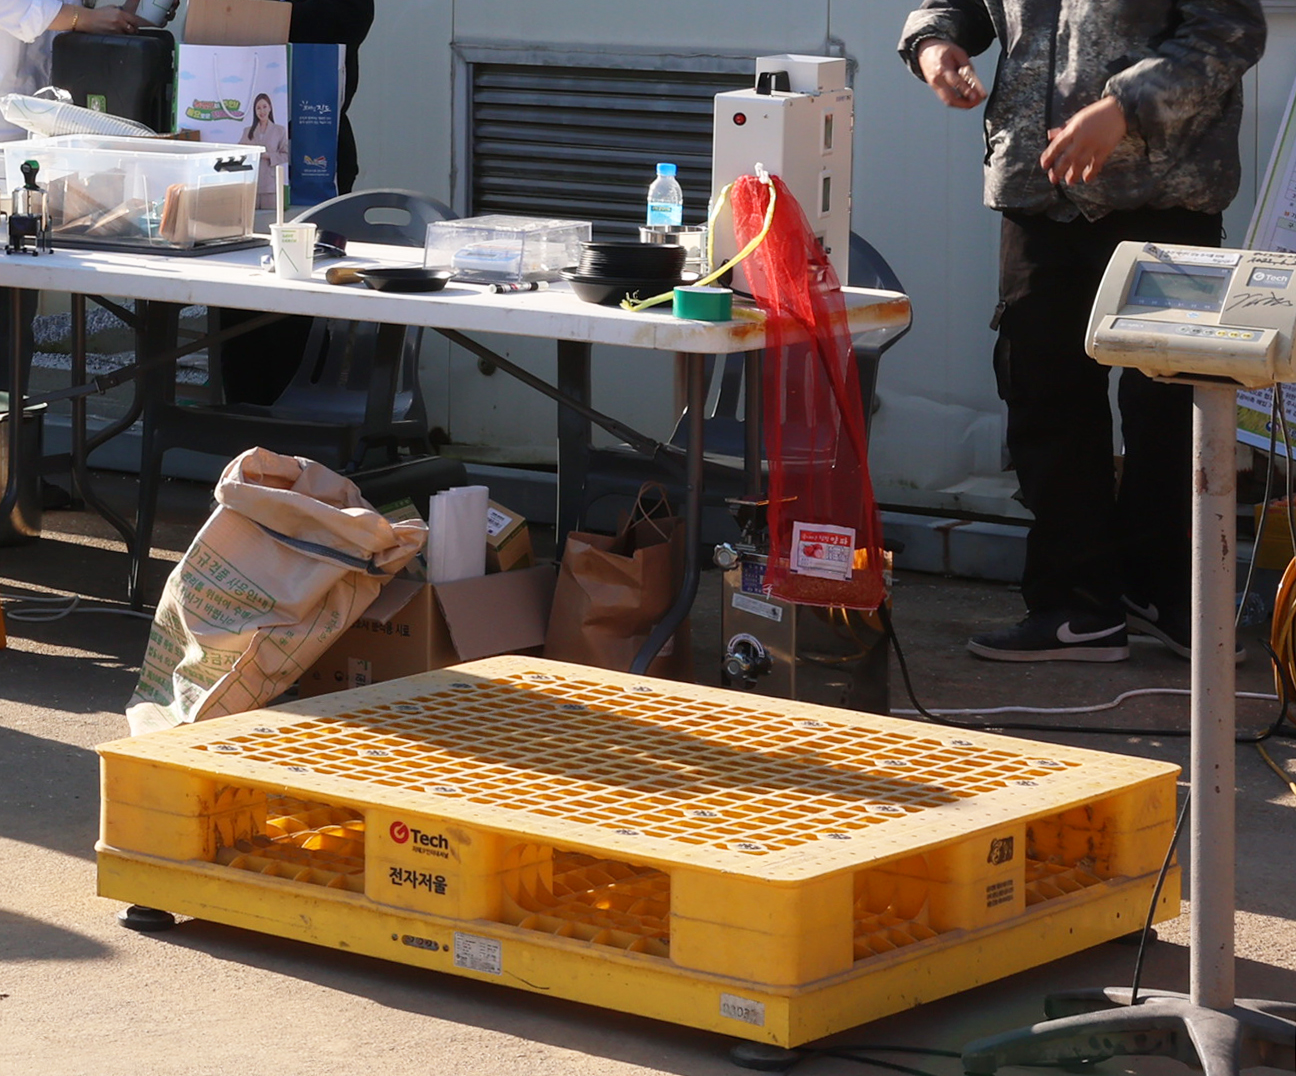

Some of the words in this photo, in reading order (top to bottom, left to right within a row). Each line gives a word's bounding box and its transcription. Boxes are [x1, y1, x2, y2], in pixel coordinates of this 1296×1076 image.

[395, 623, 411, 637] 시료
[410, 828, 449, 850] Tech
[389, 866, 448, 895] 전자저울
